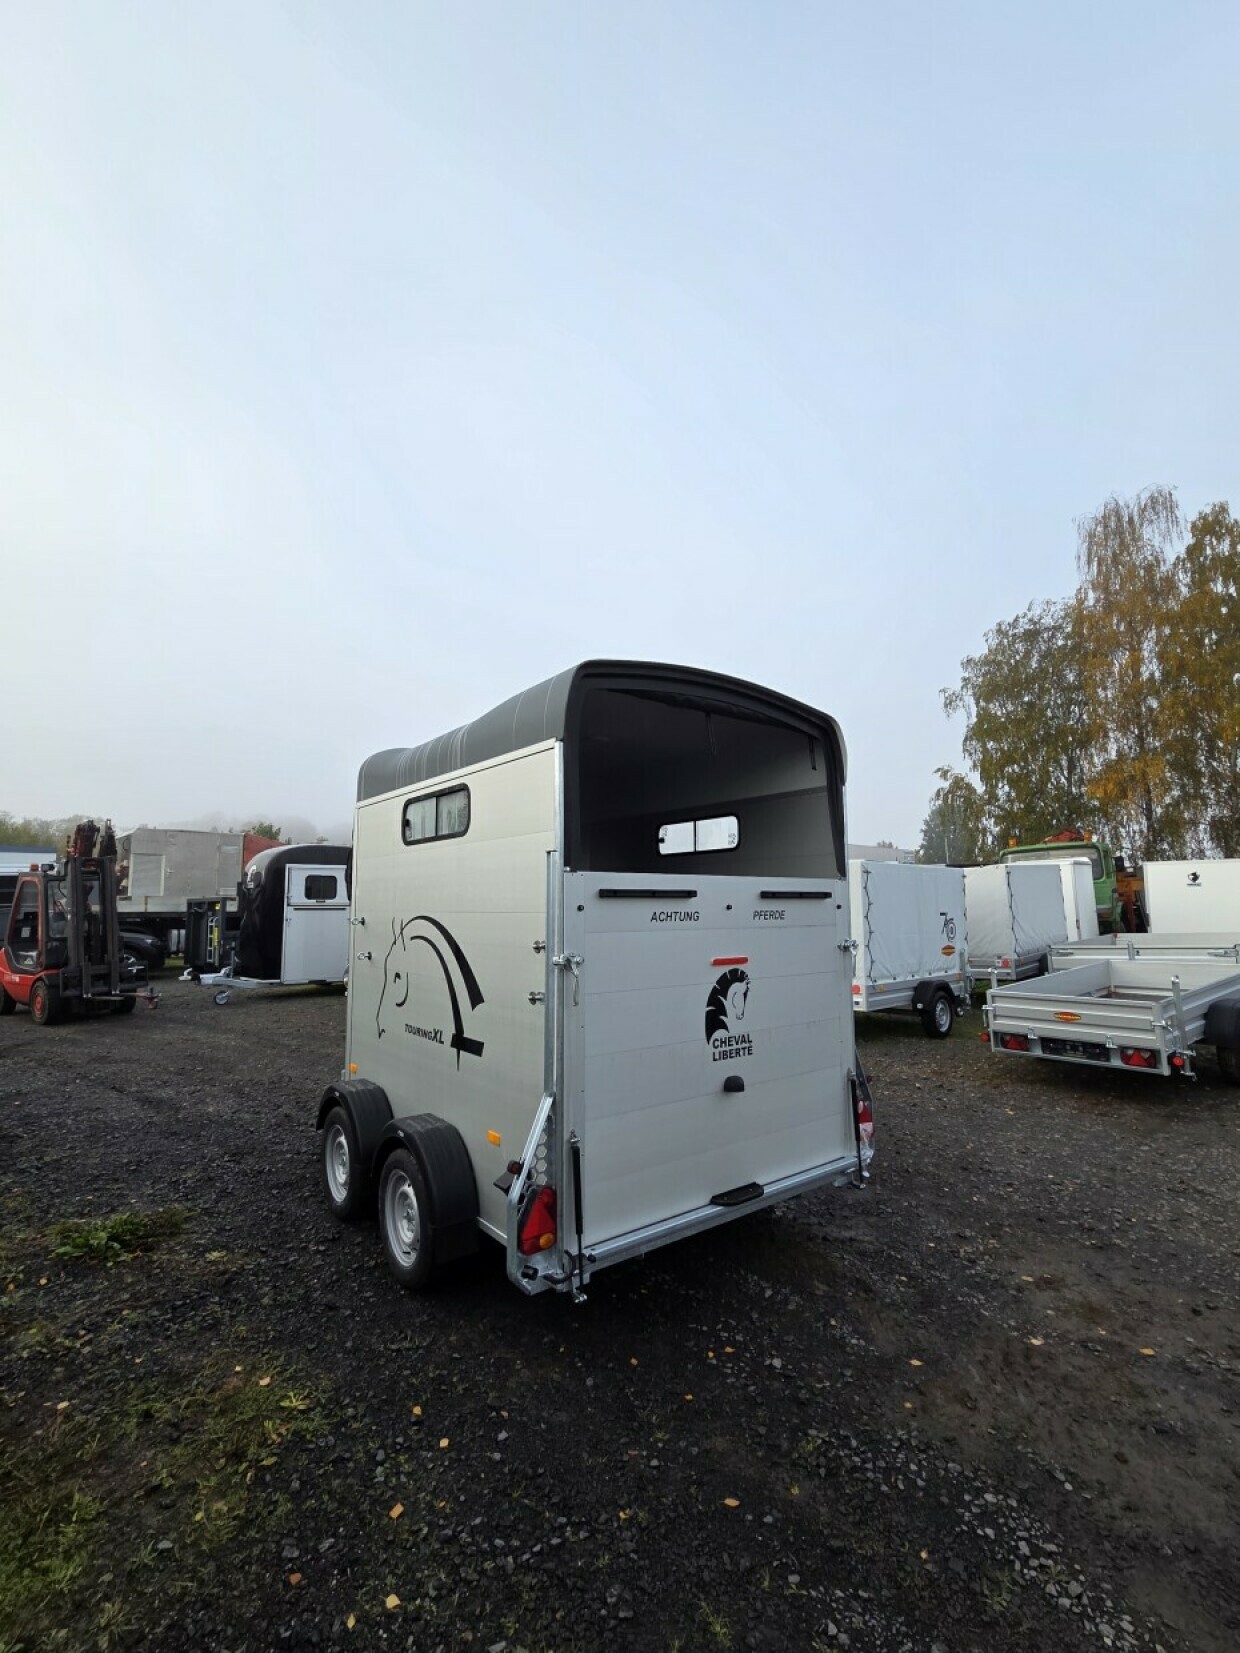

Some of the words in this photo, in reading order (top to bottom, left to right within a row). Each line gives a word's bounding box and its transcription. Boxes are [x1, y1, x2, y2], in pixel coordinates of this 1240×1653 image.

[650, 911, 700, 922] ACHTUNG
[752, 910, 786, 921] PFERDE
[712, 1033, 753, 1049] CHEVAL
[712, 1046, 753, 1062] LIBERTE
